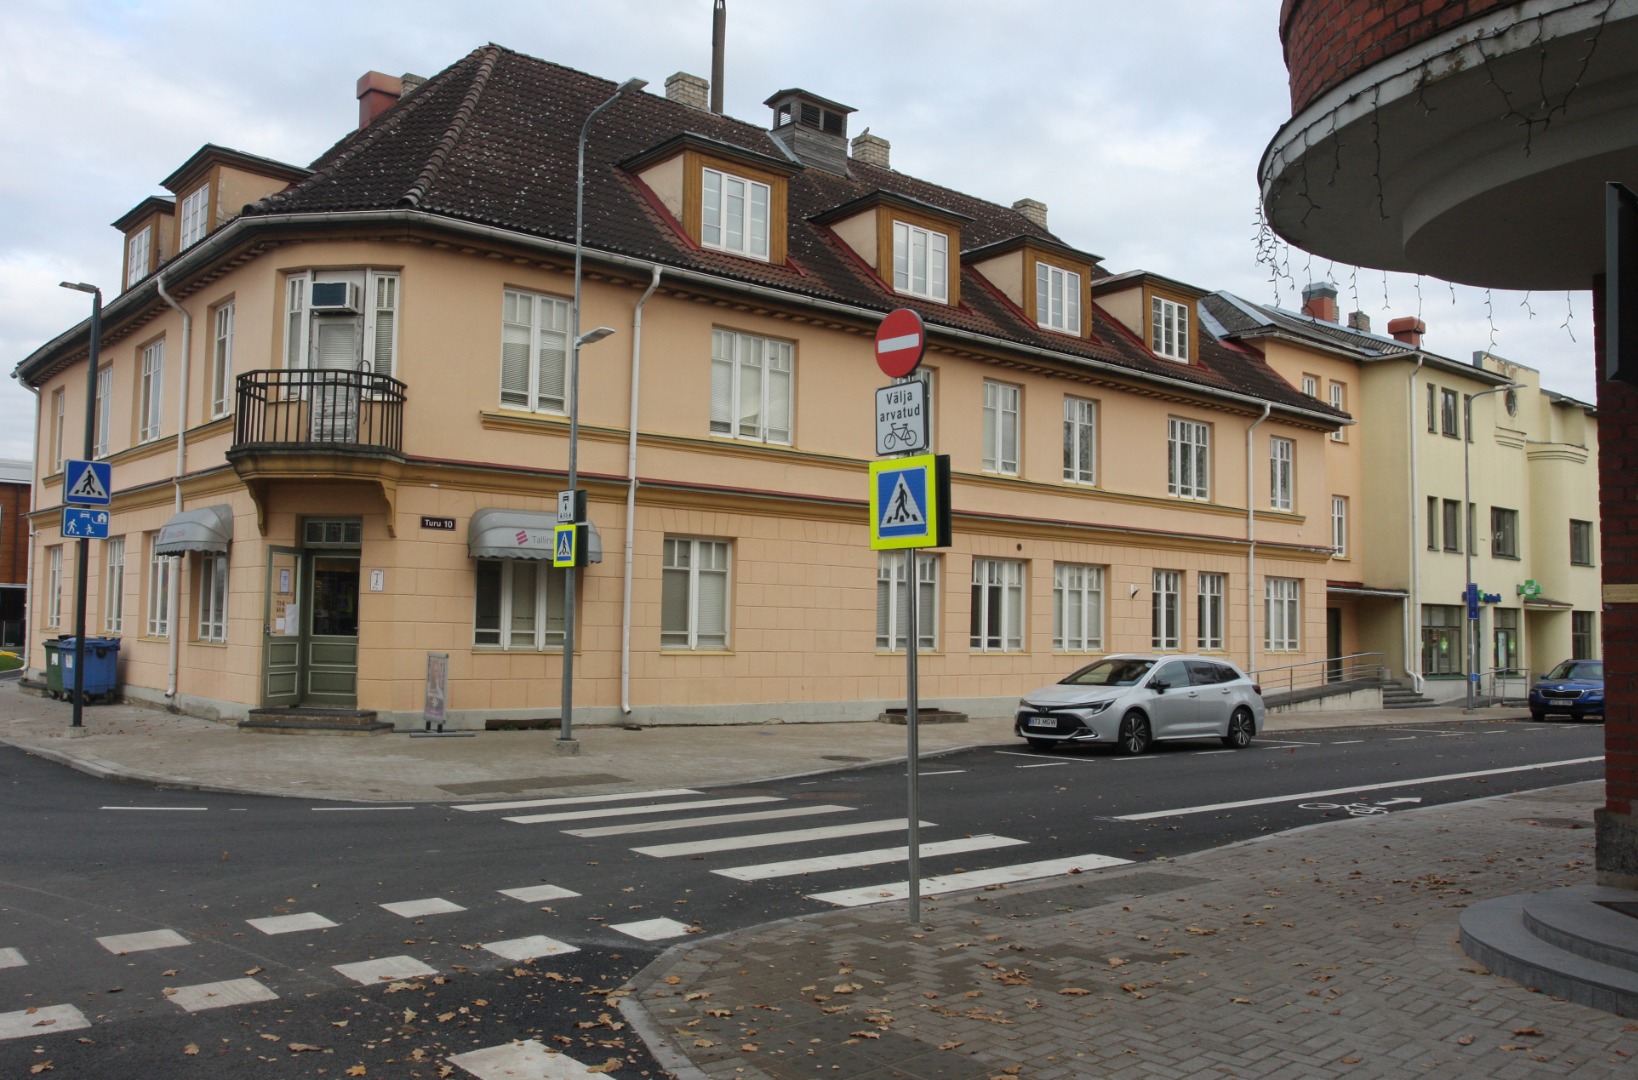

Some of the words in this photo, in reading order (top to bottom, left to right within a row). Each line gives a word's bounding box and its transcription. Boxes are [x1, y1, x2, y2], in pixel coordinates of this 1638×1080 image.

[886, 390, 913, 405] Välja
[880, 403, 920, 422] arvatud
[424, 519, 441, 527] Turu
[444, 520, 453, 528] 10
